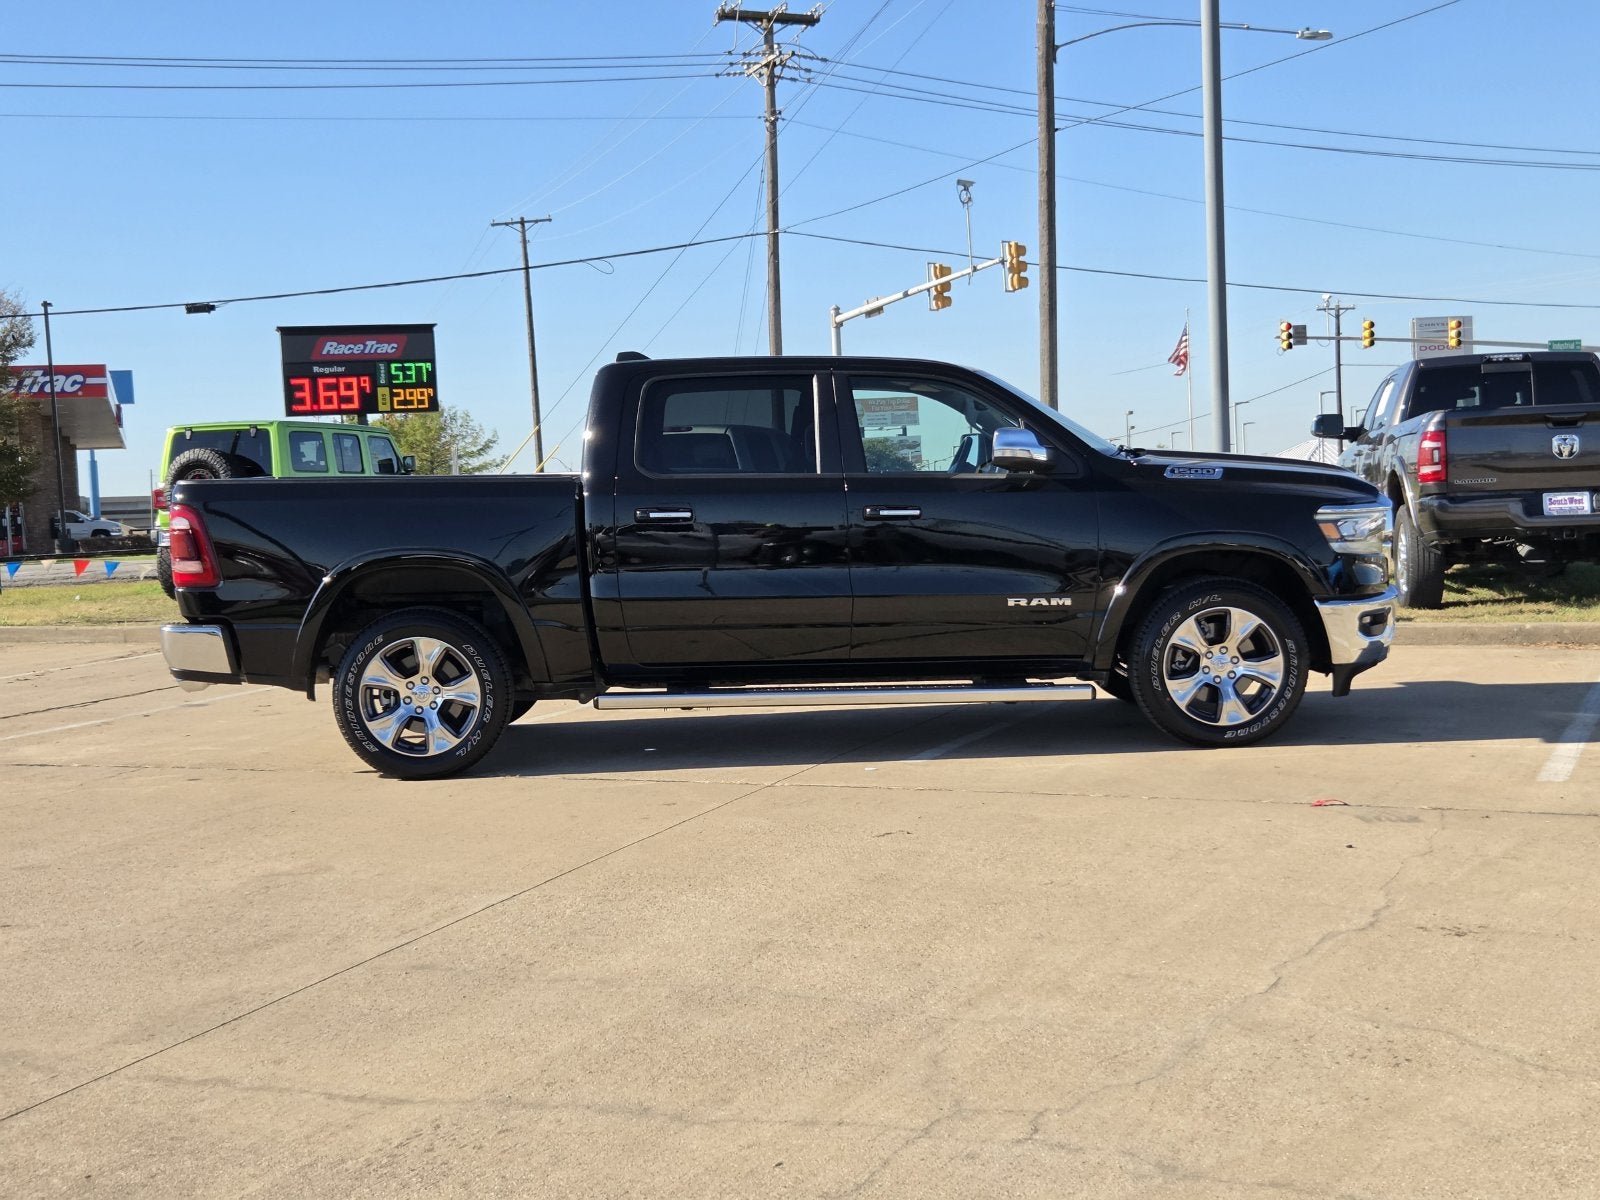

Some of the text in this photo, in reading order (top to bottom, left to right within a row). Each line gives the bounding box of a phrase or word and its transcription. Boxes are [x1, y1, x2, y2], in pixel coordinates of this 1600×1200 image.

[312, 365, 346, 374] Regular
[322, 340, 398, 354] RaceTrac
[1007, 597, 1072, 606] RAM
[462, 644, 494, 723] DUELER
[1152, 611, 1181, 691] DUELER
[1223, 638, 1298, 738] BRIDGESTONE
[345, 634, 384, 753] BRIDGESTONE
